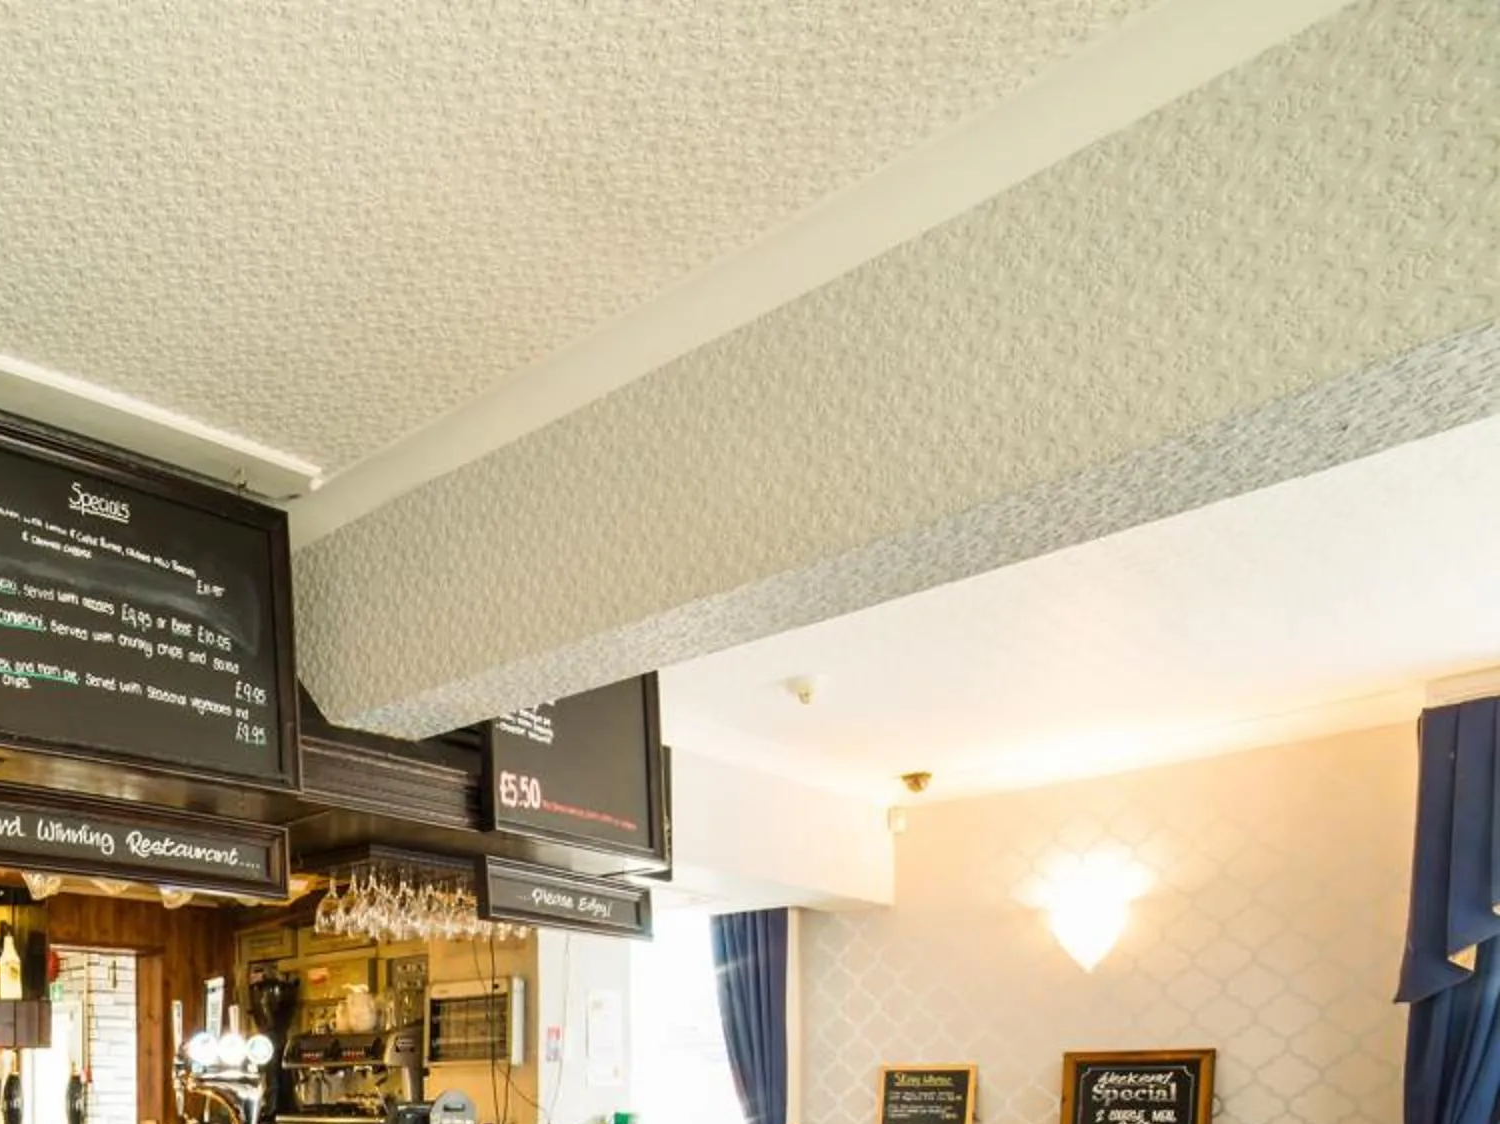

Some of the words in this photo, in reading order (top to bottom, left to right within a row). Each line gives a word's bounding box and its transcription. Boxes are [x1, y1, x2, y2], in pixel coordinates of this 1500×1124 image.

[68, 482, 131, 524] Specials
[500, 769, 541, 810] £5.50
[36, 818, 116, 855] Winning
[1092, 1082, 1177, 1107] Special
